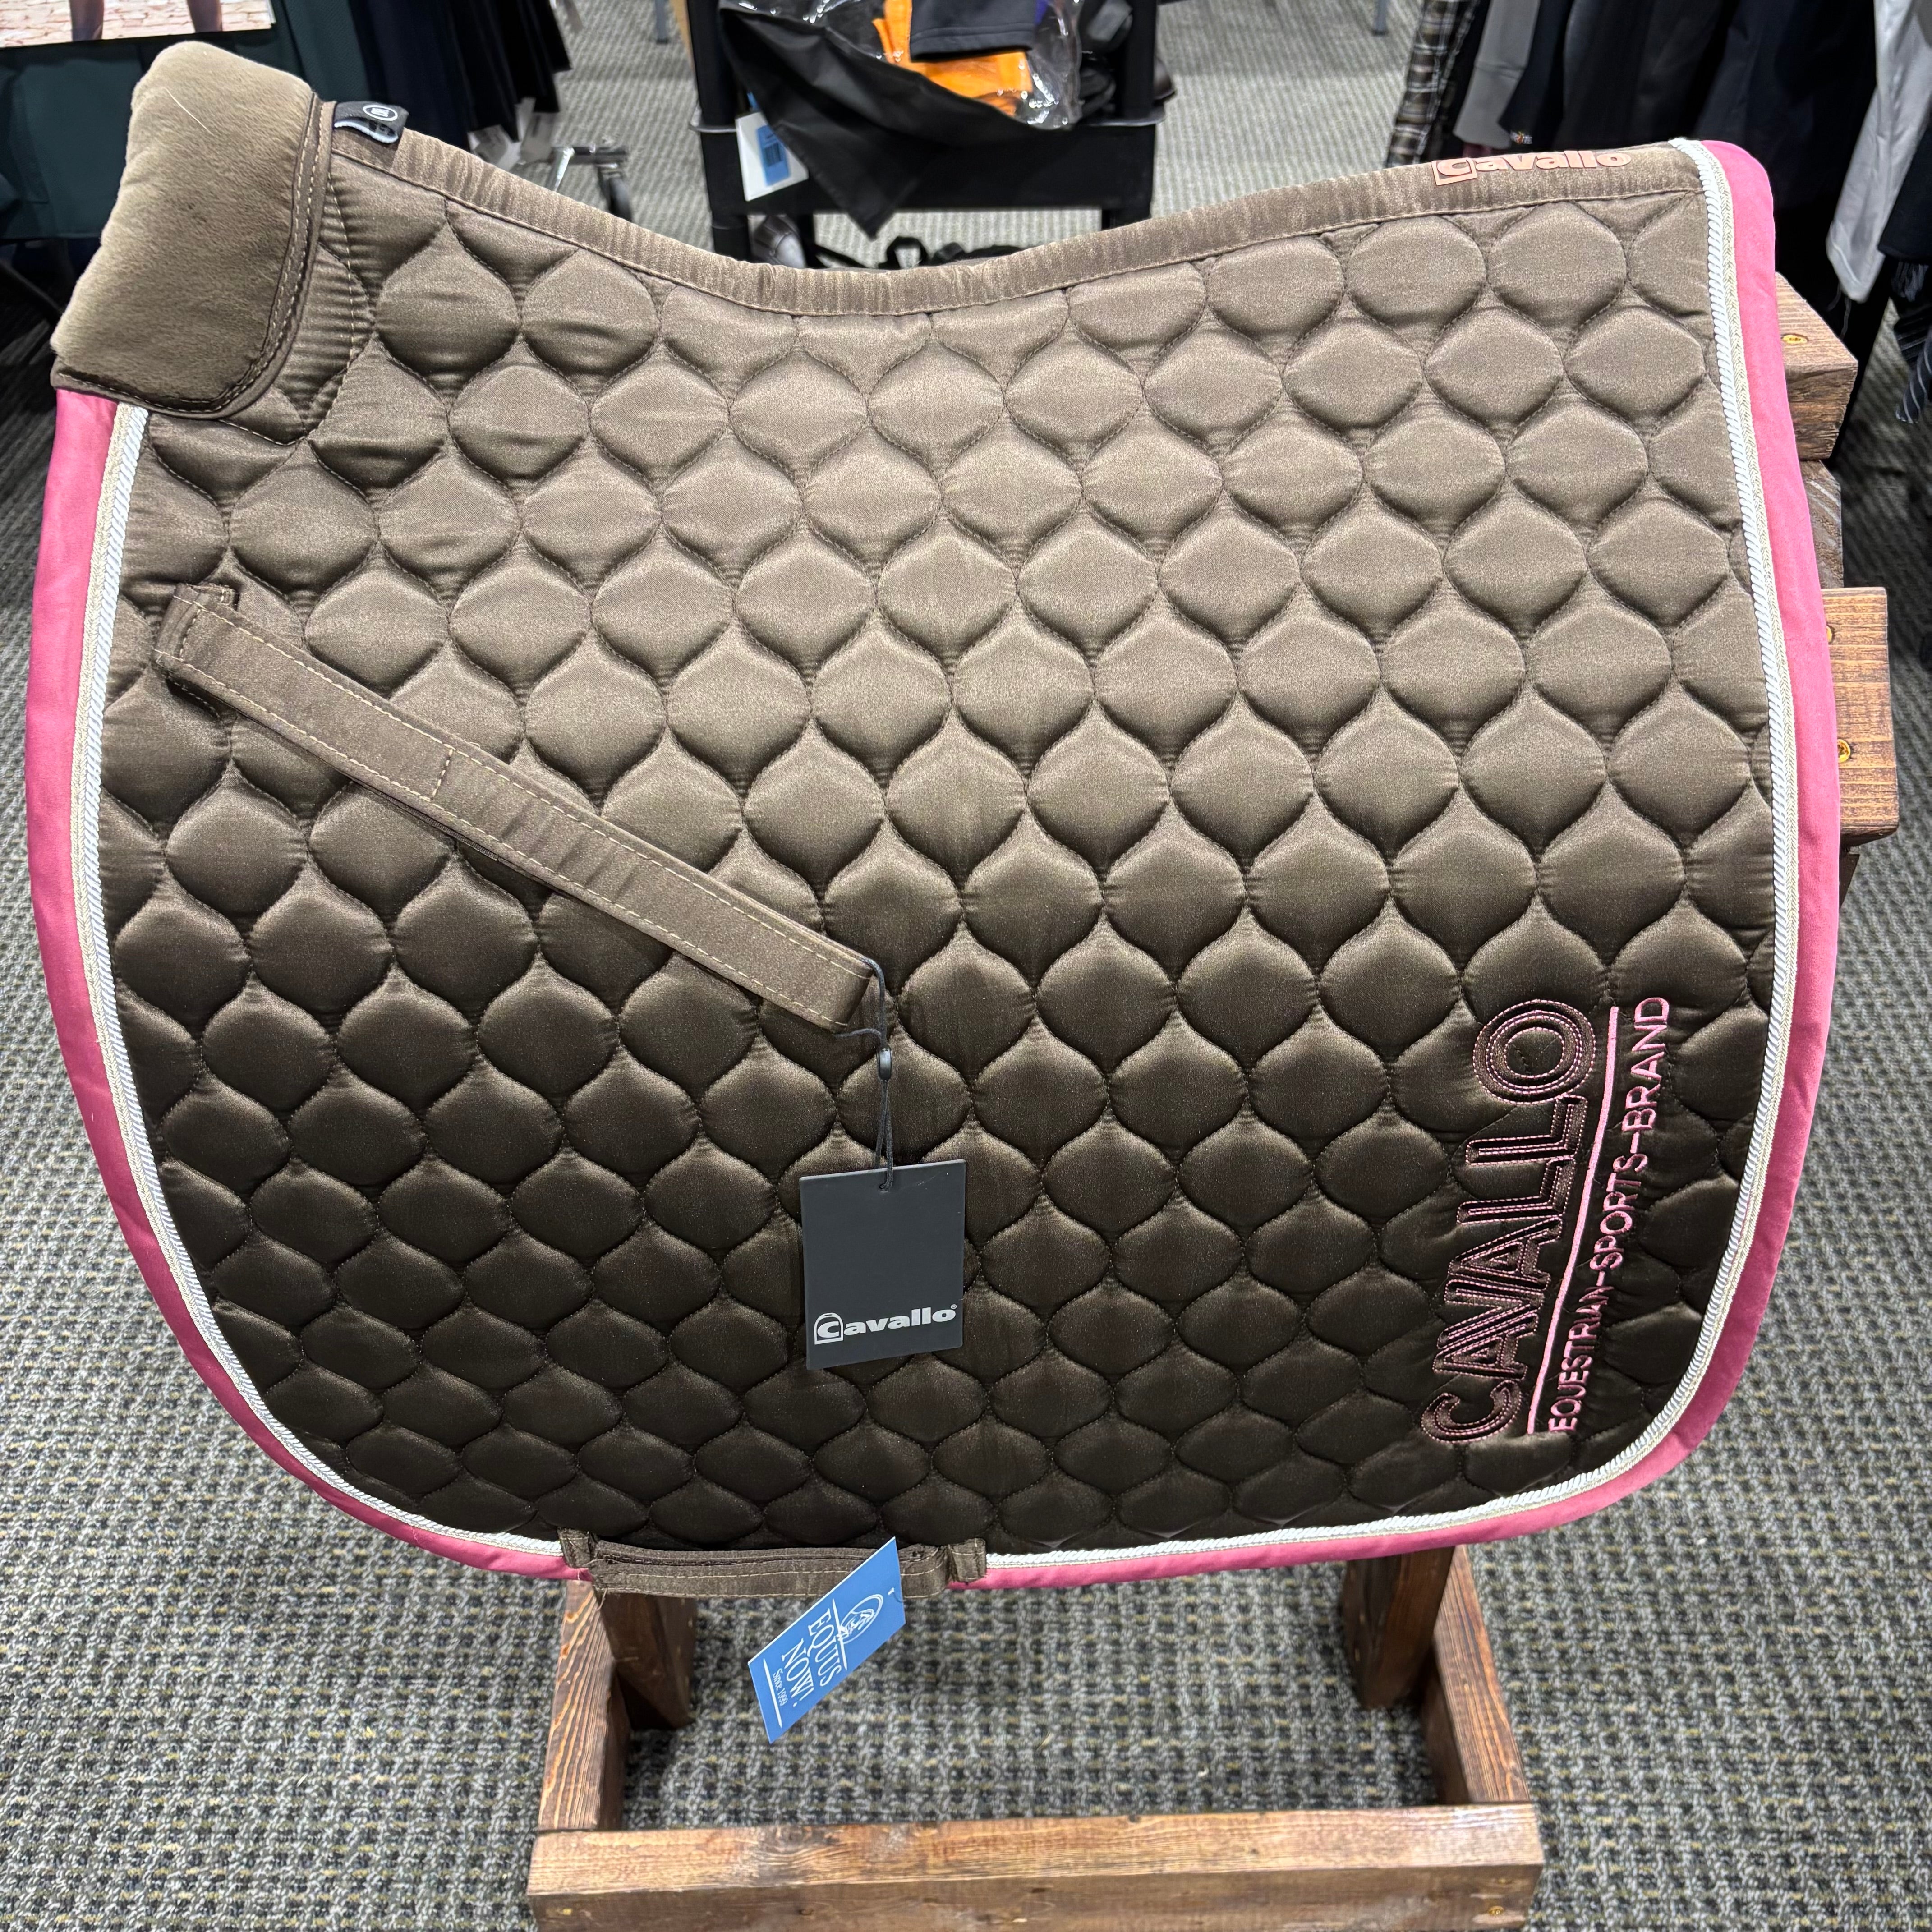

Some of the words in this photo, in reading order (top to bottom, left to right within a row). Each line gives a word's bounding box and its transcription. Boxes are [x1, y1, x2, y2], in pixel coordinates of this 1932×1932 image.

[1431, 150, 1631, 186] Cavallo
[1421, 998, 1596, 1444] CAVALLO
[781, 1638, 814, 1707] NOW!
[807, 1608, 842, 1687] EQUUS
[772, 1668, 783, 1691] Since
[777, 1688, 788, 1706] 1999
